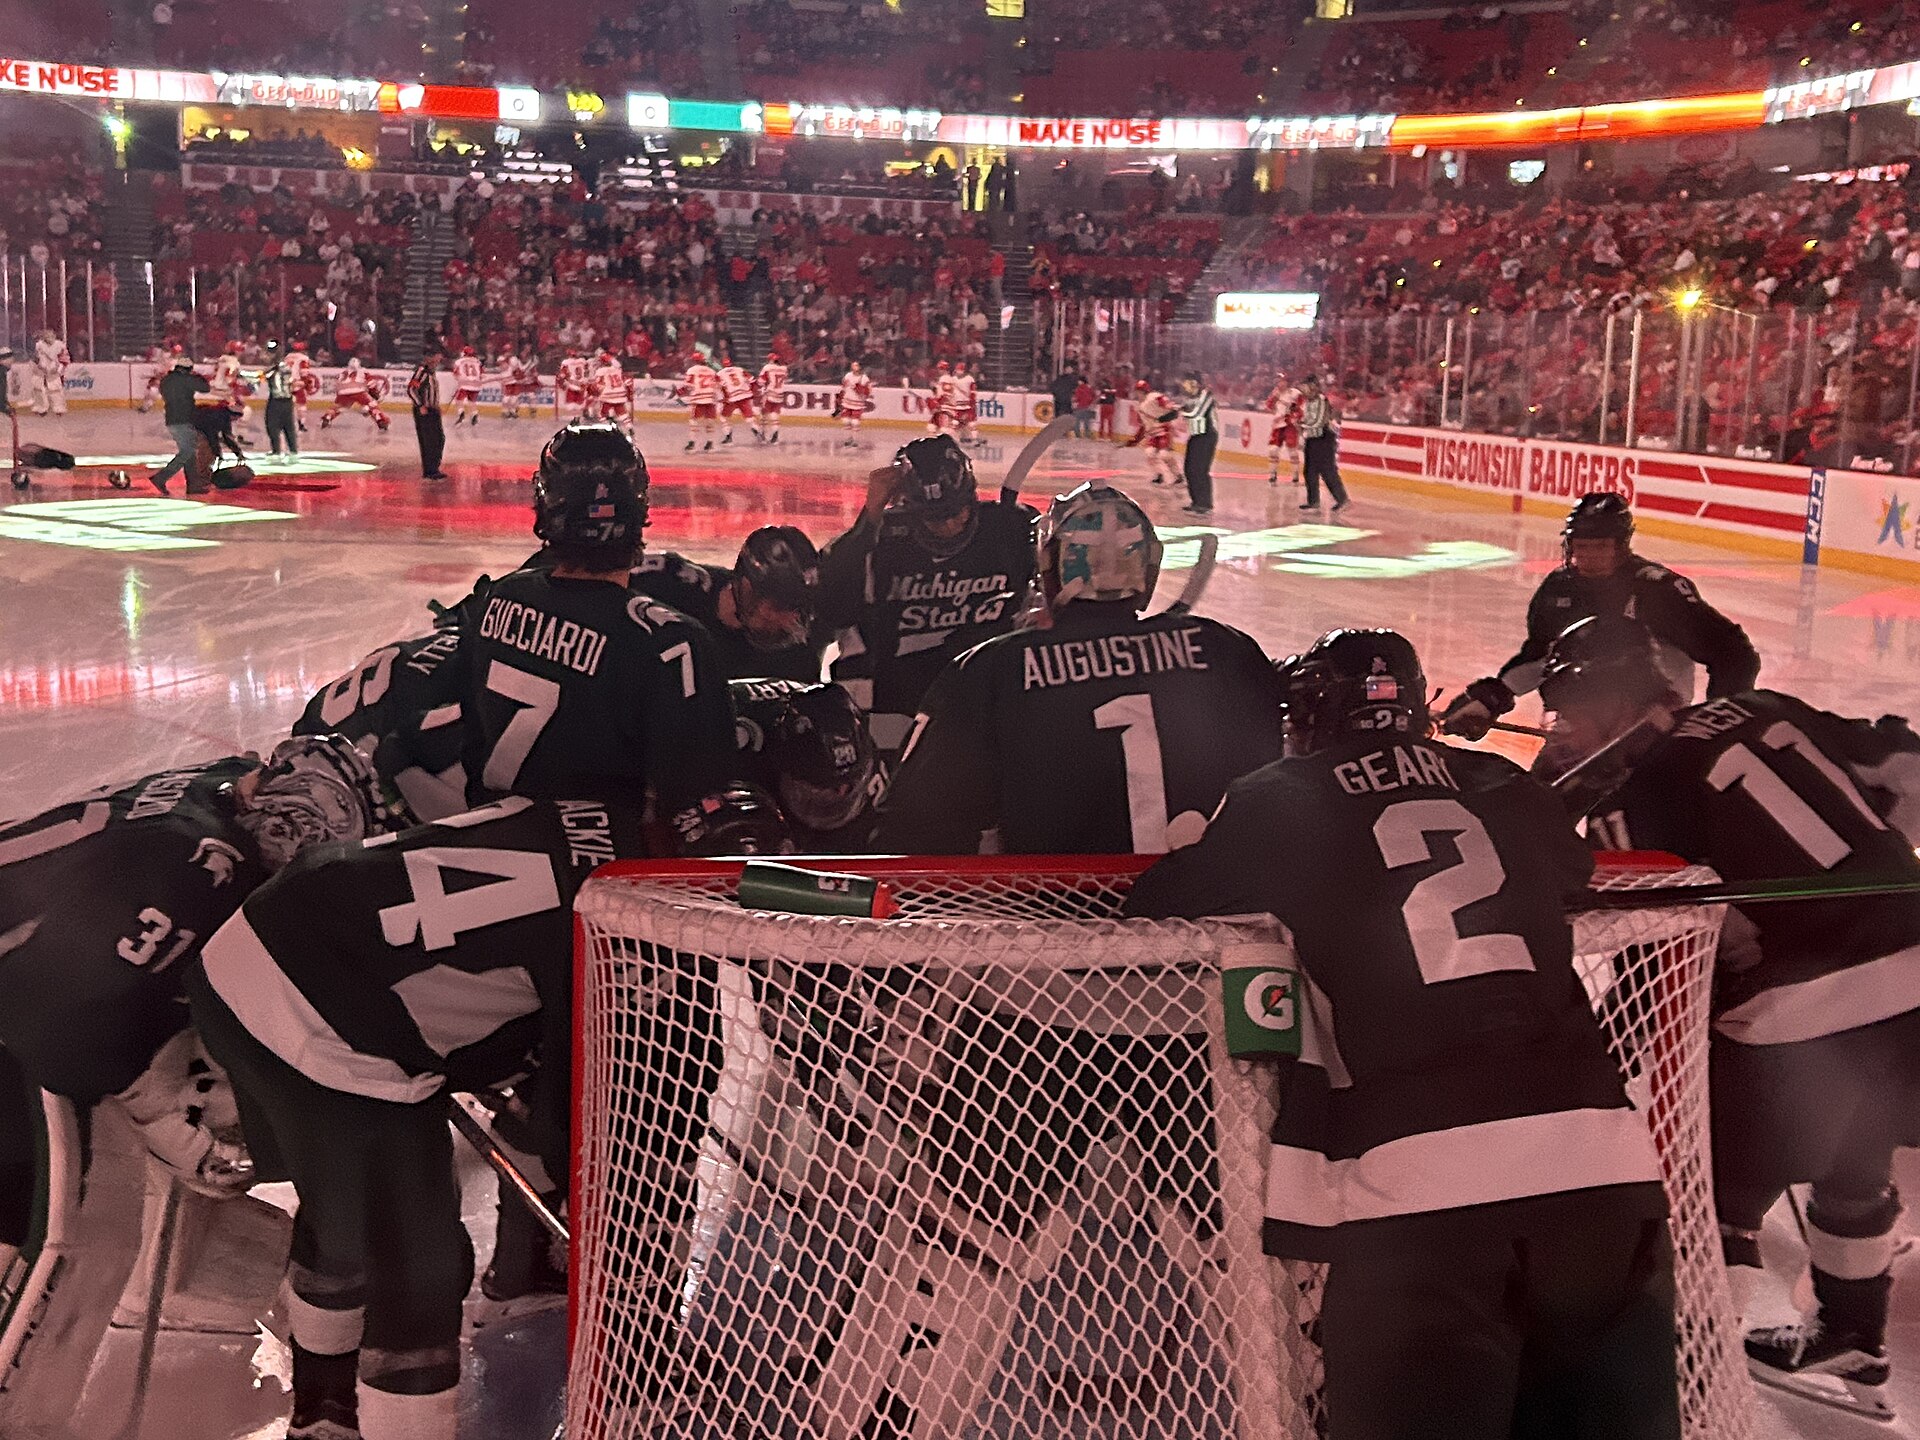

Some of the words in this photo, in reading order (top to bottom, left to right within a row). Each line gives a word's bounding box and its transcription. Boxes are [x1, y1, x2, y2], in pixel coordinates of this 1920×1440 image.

[39, 63, 119, 92] NOISE
[1019, 118, 1085, 144] MAKE
[1092, 117, 1161, 145] NOISE
[1426, 436, 1524, 490] WISCONSIN
[1529, 447, 1636, 506] BADGERS
[1806, 472, 1825, 545] CCM
[886, 569, 1009, 607] Michigan
[479, 597, 608, 677] GUCCIARDI
[659, 640, 697, 698] 7
[1023, 626, 1209, 690] AUGUSTINE
[482, 658, 562, 792] 7
[1093, 693, 1171, 855] 1
[1333, 744, 1461, 795] GEAR
[1706, 721, 1890, 870] 11
[553, 799, 617, 867] ACKIE
[1372, 799, 1538, 984] 2
[116, 907, 197, 974] 31
[1243, 971, 1295, 1030] G
